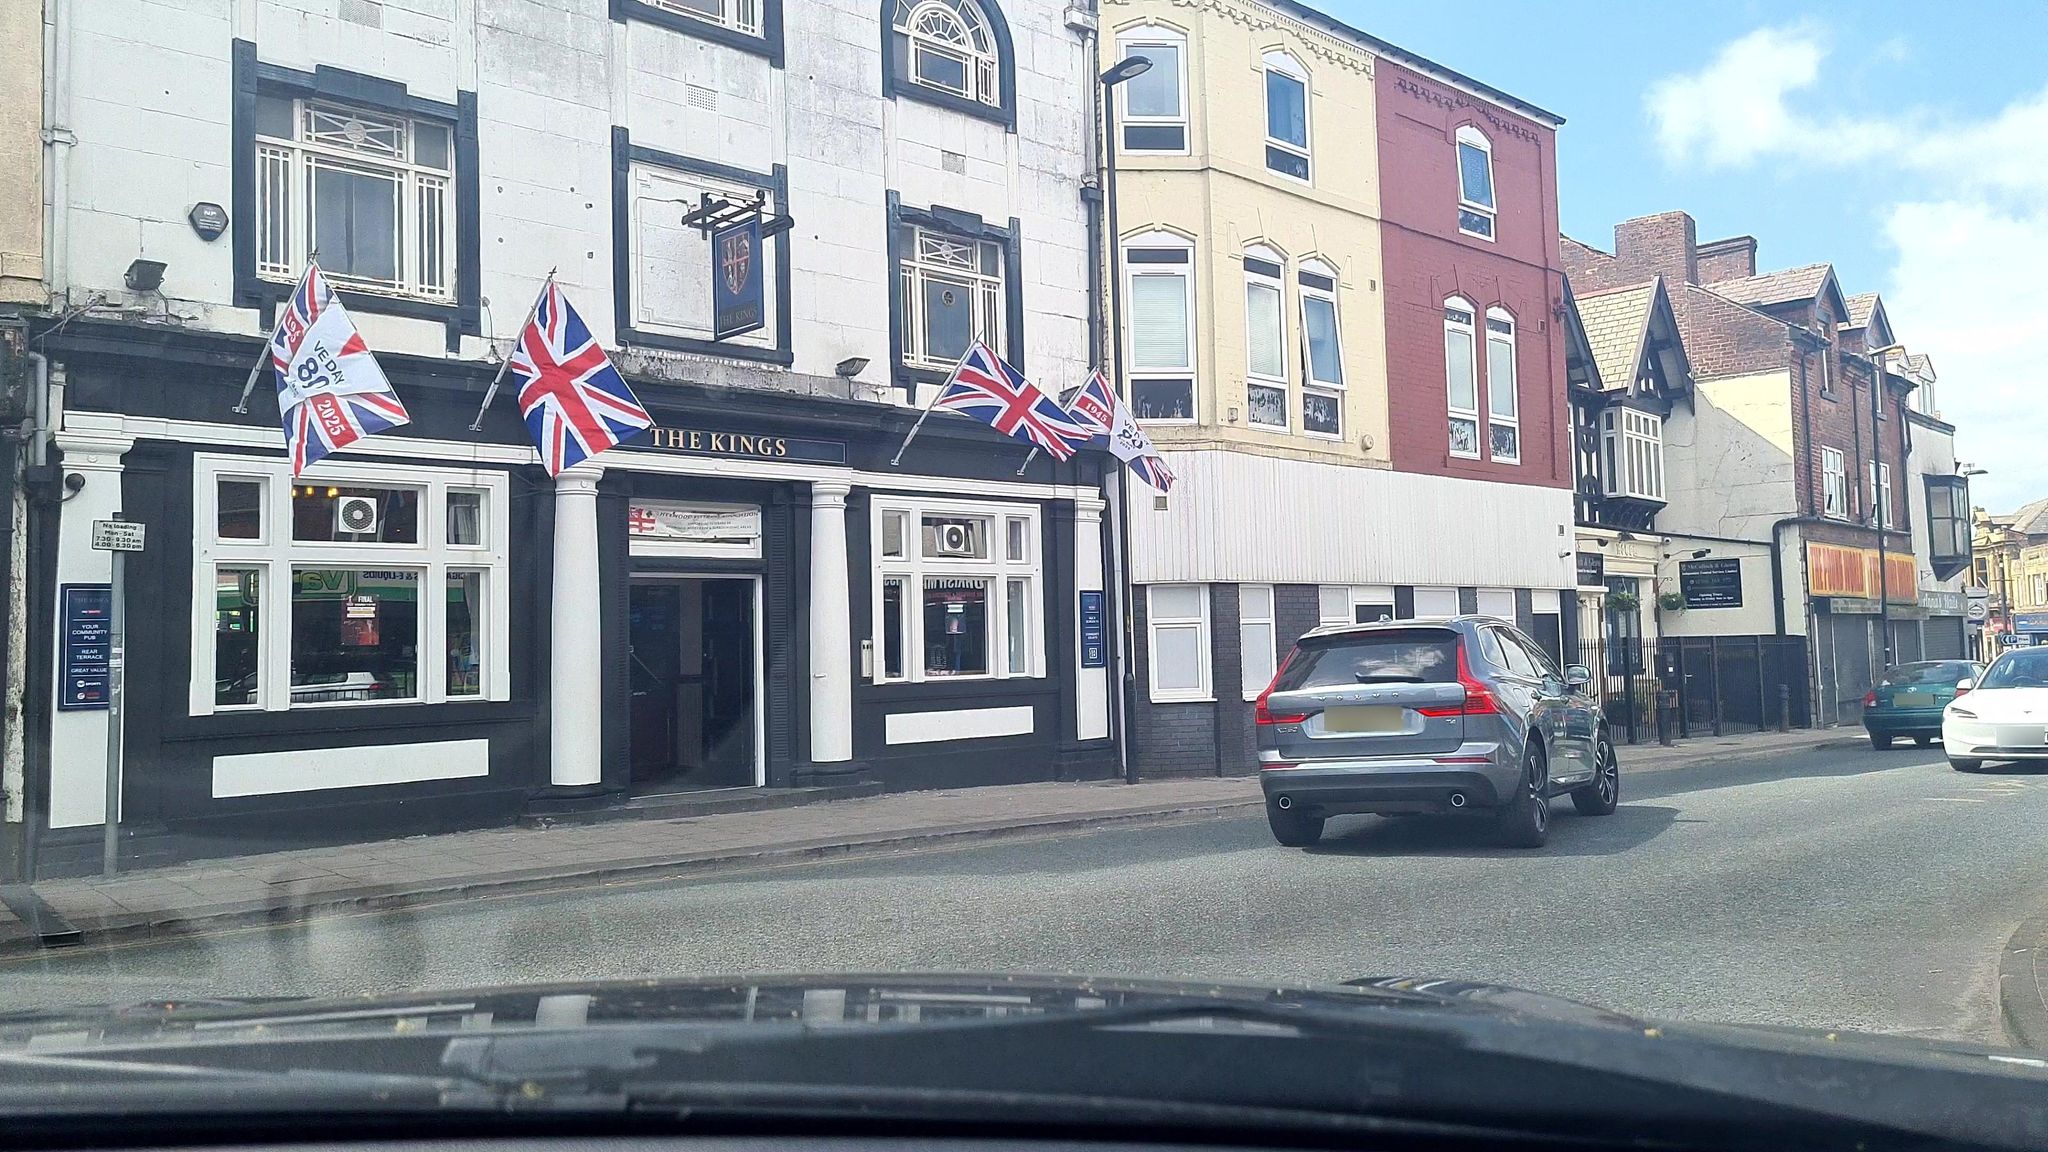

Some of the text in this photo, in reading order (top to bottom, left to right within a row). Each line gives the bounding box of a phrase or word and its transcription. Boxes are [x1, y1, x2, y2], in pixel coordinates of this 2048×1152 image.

[313, 340, 345, 386] VE DAY
[317, 400, 346, 436] 2025
[1085, 402, 1108, 422] 1945
[650, 428, 787, 456] THE KINGS
[114, 523, 137, 531] loading
[1318, 691, 1399, 702] VOLVO
